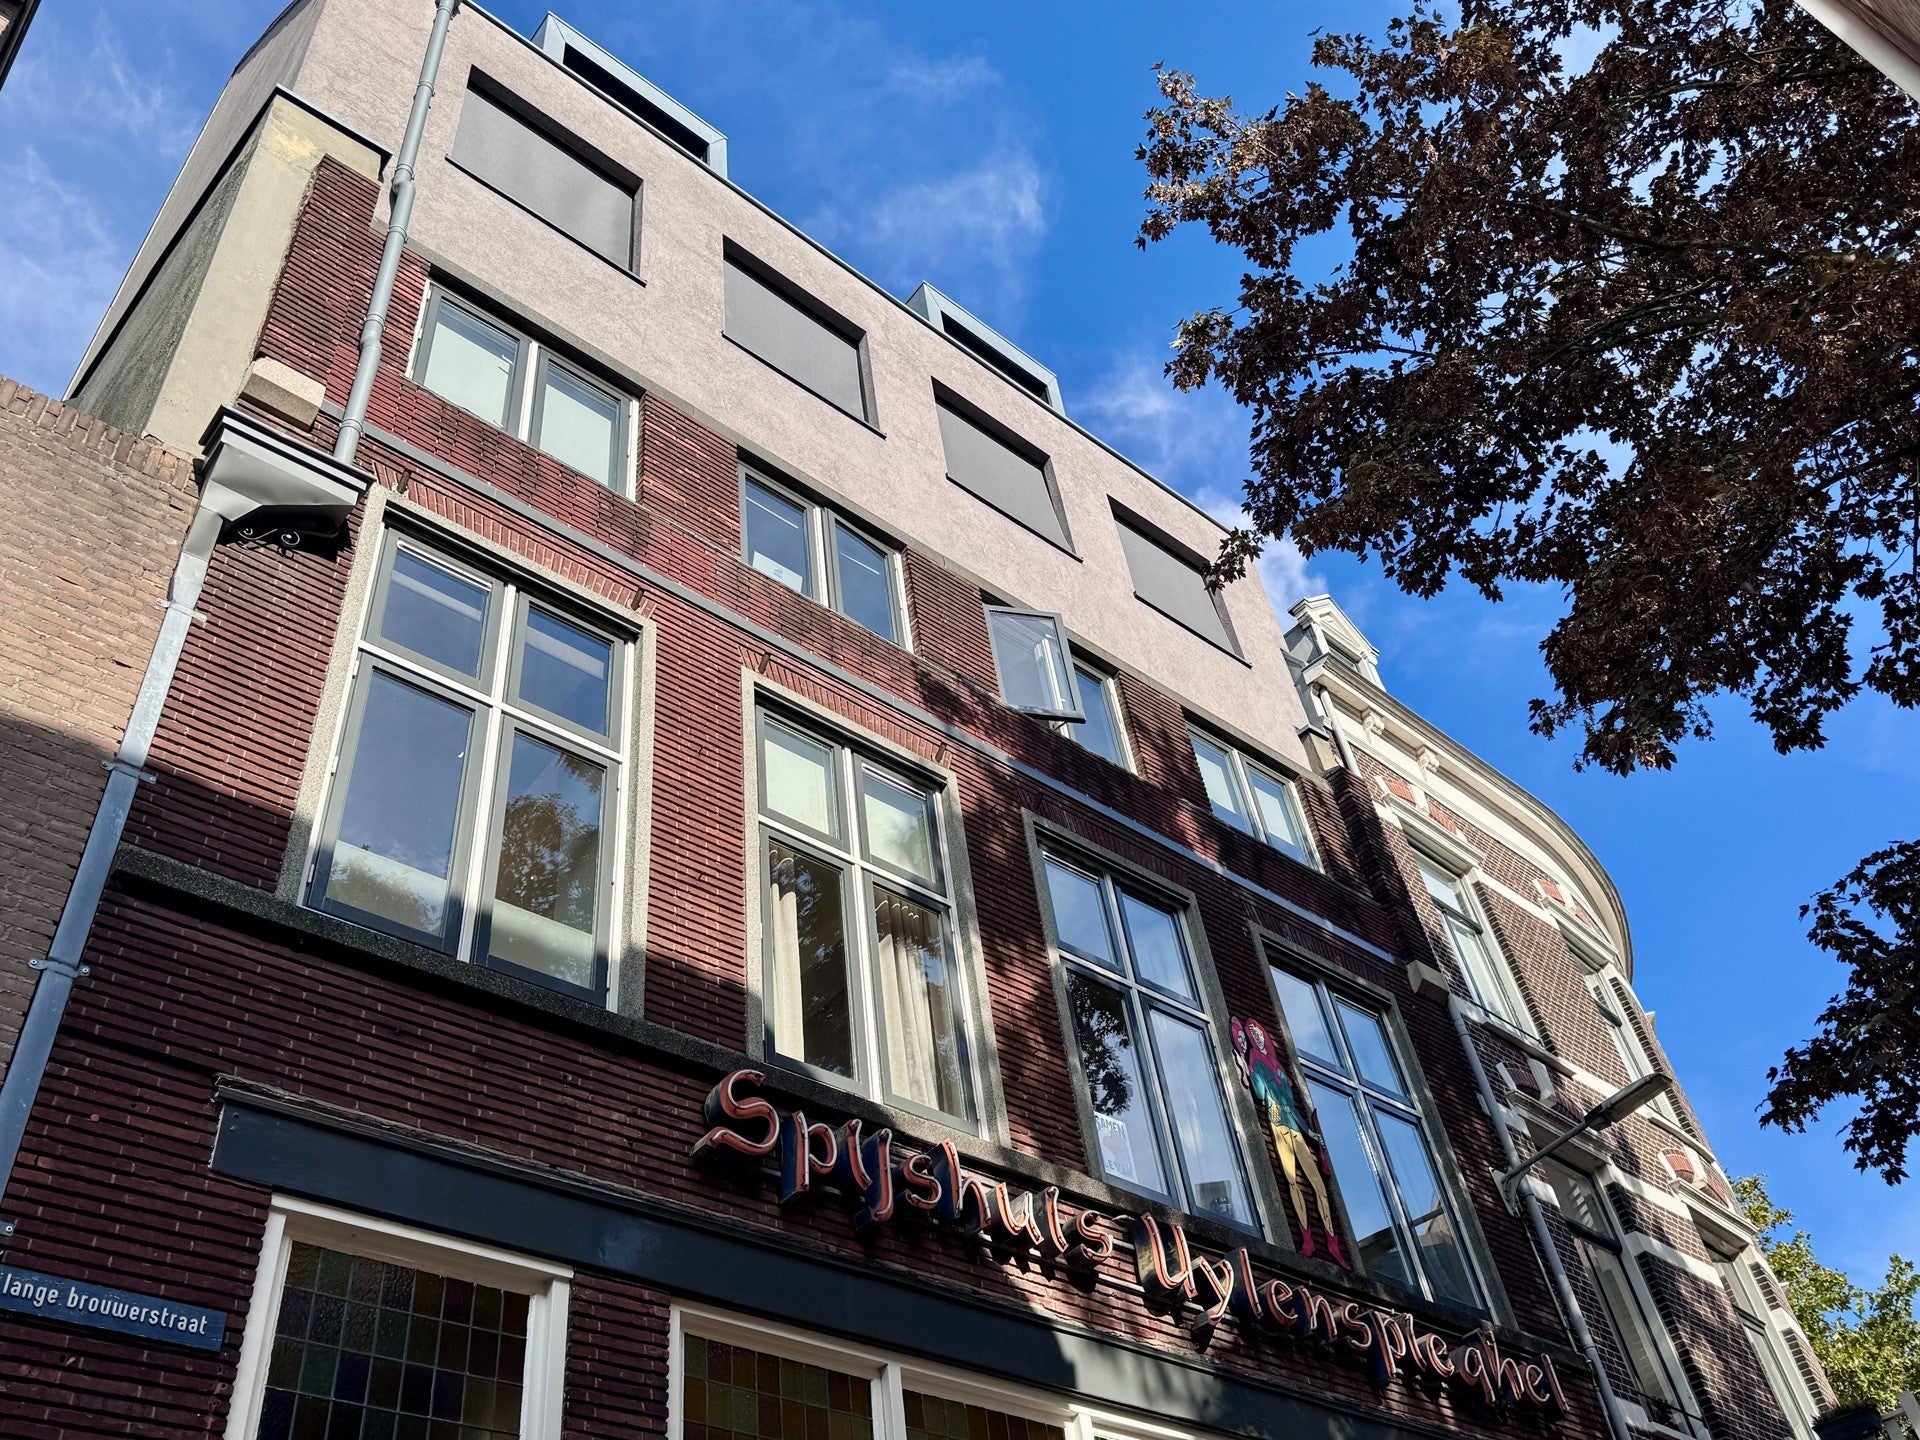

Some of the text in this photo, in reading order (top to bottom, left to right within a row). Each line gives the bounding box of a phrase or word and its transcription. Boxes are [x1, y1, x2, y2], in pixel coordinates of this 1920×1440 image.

[3, 1273, 207, 1335] lange brouwerstraat
[1130, 1211, 1569, 1414] Uylenspieghel
